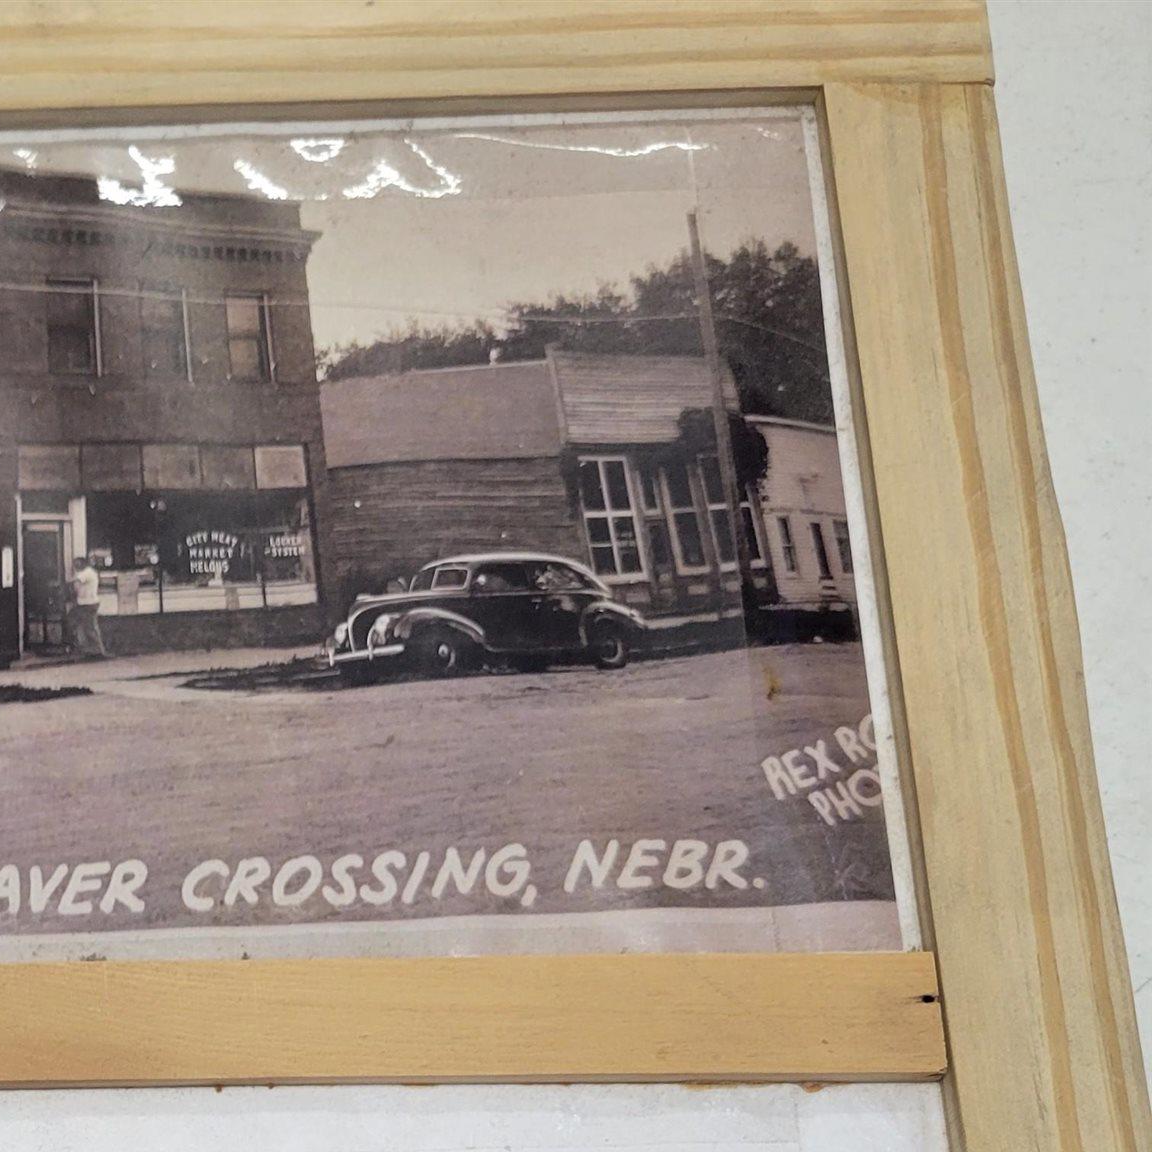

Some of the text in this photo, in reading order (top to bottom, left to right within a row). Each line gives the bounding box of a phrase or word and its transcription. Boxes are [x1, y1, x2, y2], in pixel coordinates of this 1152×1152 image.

[189, 546, 234, 559] MARKET
[761, 739, 841, 801] REX
[181, 843, 538, 912] CROSSING,
[563, 838, 766, 893] NEBR.
